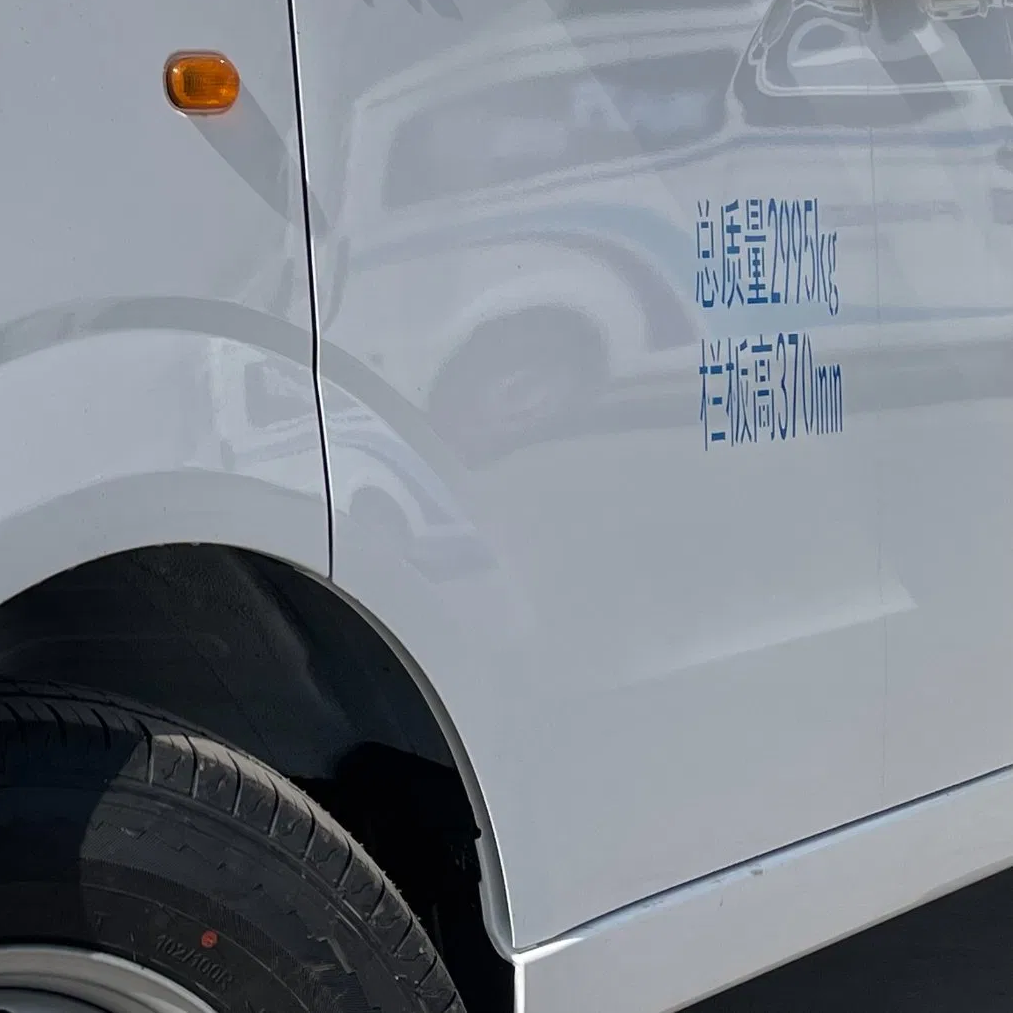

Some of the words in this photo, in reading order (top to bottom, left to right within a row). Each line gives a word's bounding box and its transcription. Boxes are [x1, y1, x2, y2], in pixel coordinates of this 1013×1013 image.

[695, 197, 839, 316] 总质量2995kg
[699, 332, 843, 452] 栏板高370mm
